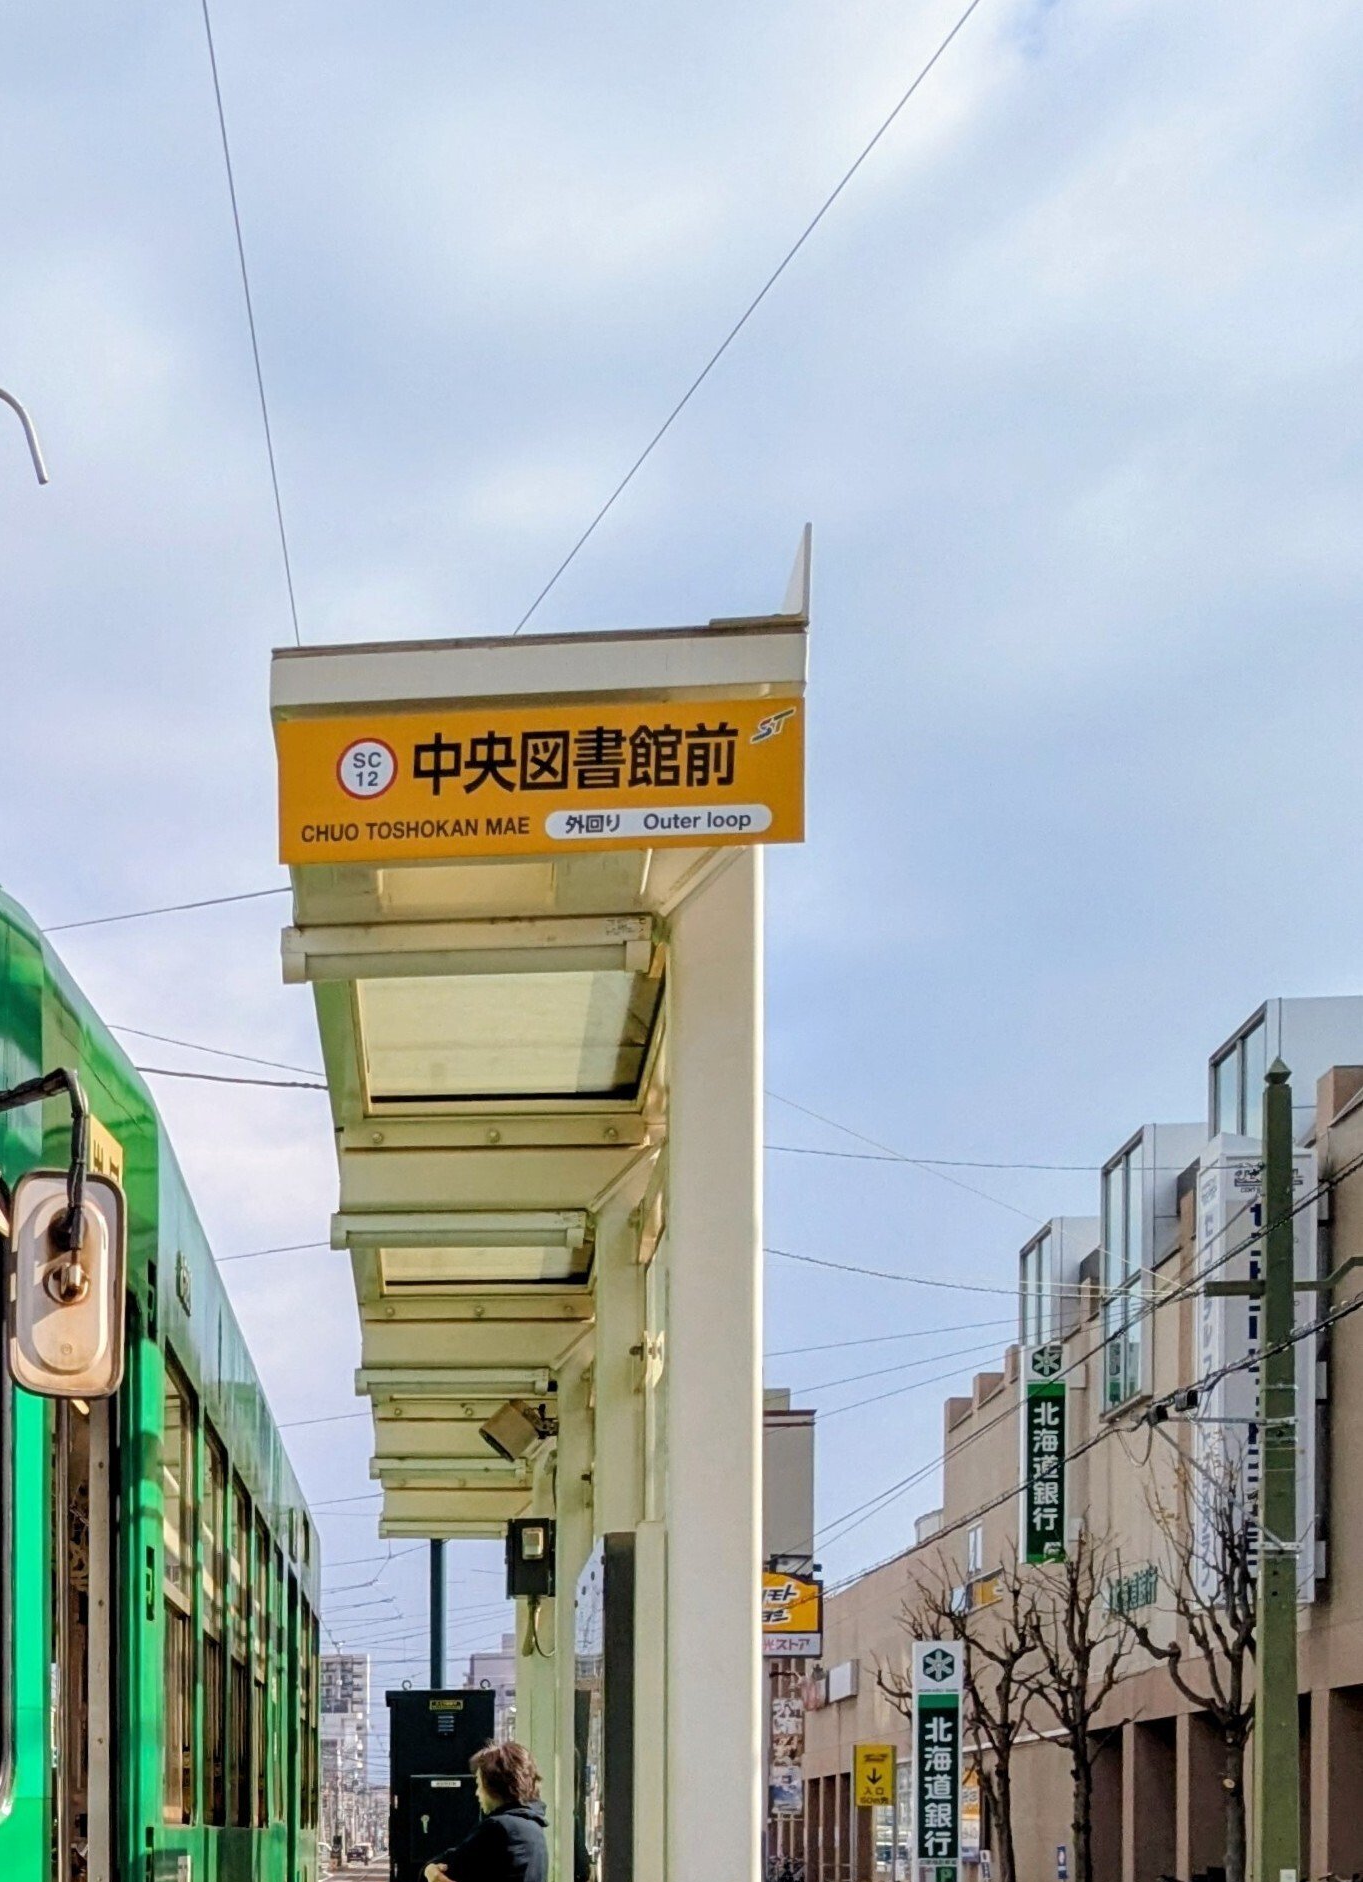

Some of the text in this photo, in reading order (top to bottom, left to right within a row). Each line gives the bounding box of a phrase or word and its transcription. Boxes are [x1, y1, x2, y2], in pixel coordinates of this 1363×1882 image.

[353, 752, 382, 769] SC
[412, 721, 738, 796] 中央図書館前
[356, 771, 378, 787] 12
[301, 816, 530, 843] CHUO TOSHOKAN MAE
[565, 813, 621, 835] 外回り
[643, 811, 752, 831] Outer loop
[1032, 1401, 1060, 1532] 北海道銀行
[924, 1716, 953, 1857] 北海道銀行
